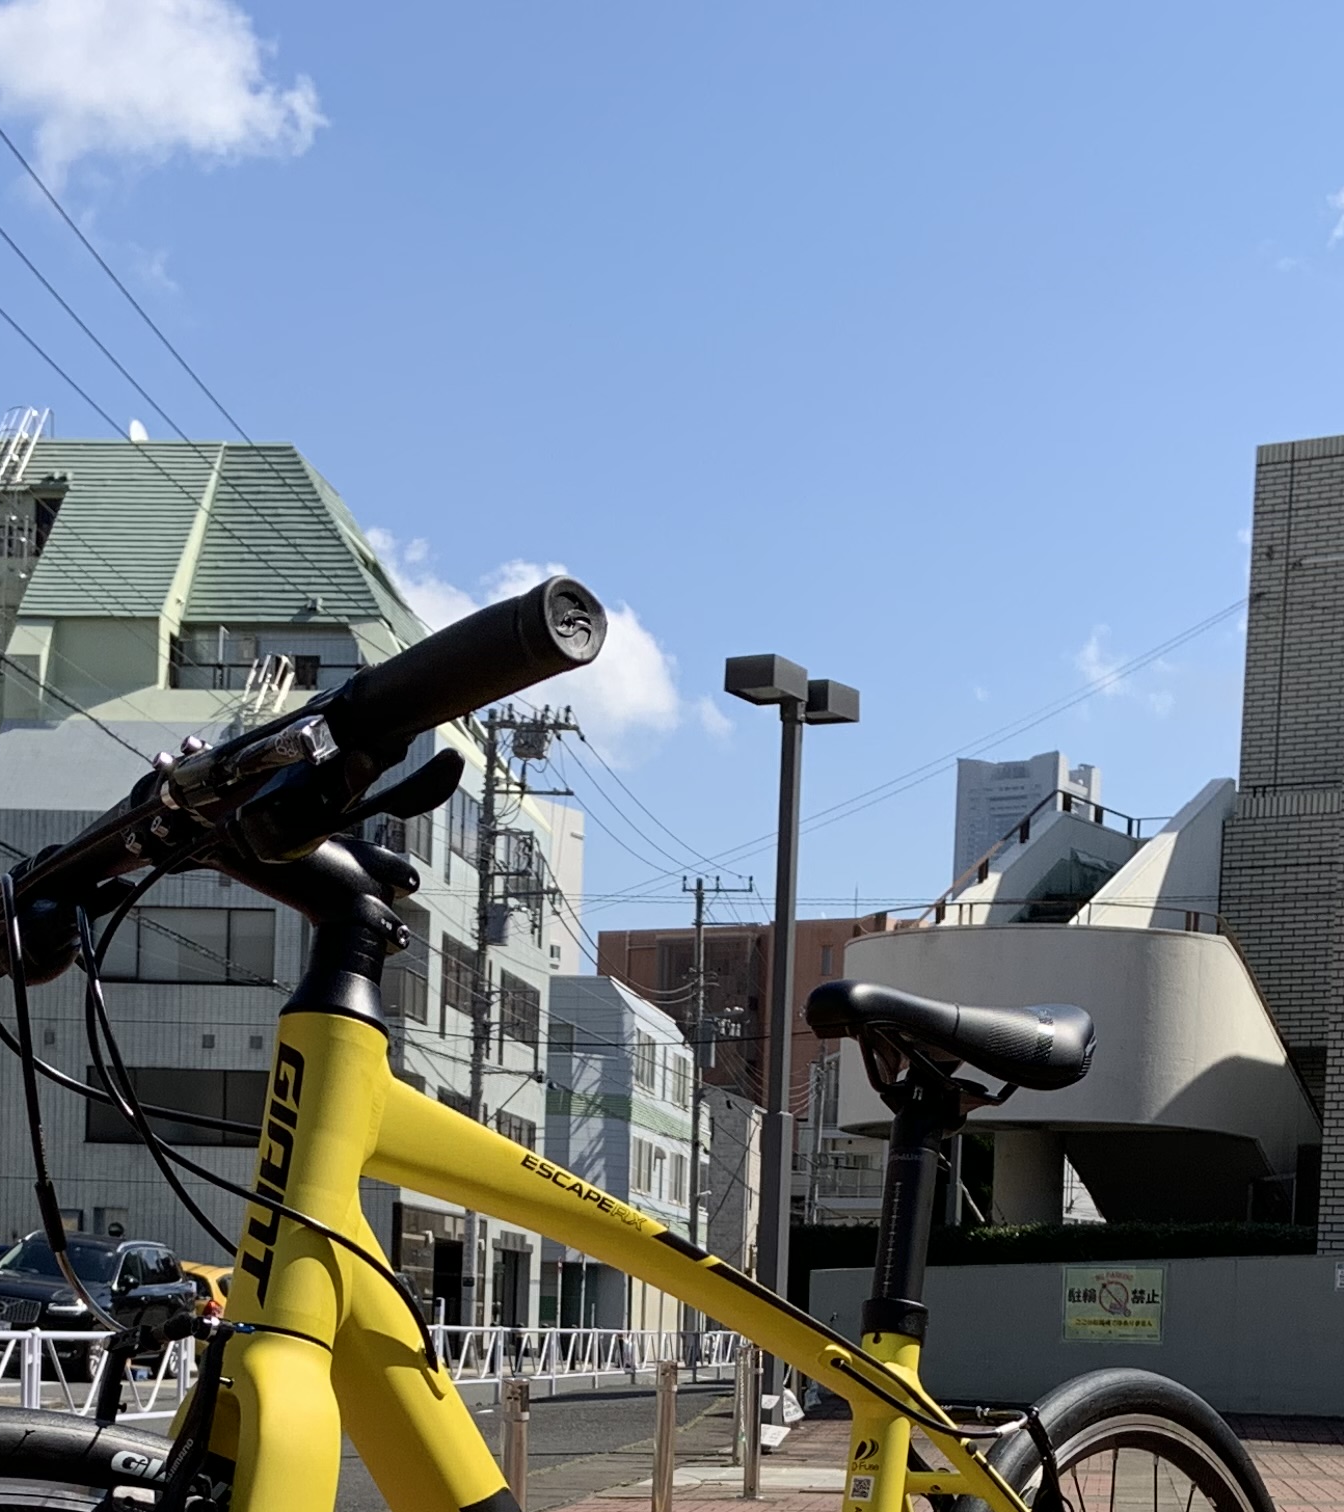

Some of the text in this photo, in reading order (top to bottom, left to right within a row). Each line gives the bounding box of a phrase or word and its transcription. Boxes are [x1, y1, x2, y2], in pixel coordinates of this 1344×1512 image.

[240, 1041, 305, 1310] GIANT
[1068, 1287, 1161, 1305] 駐輪 禁止
